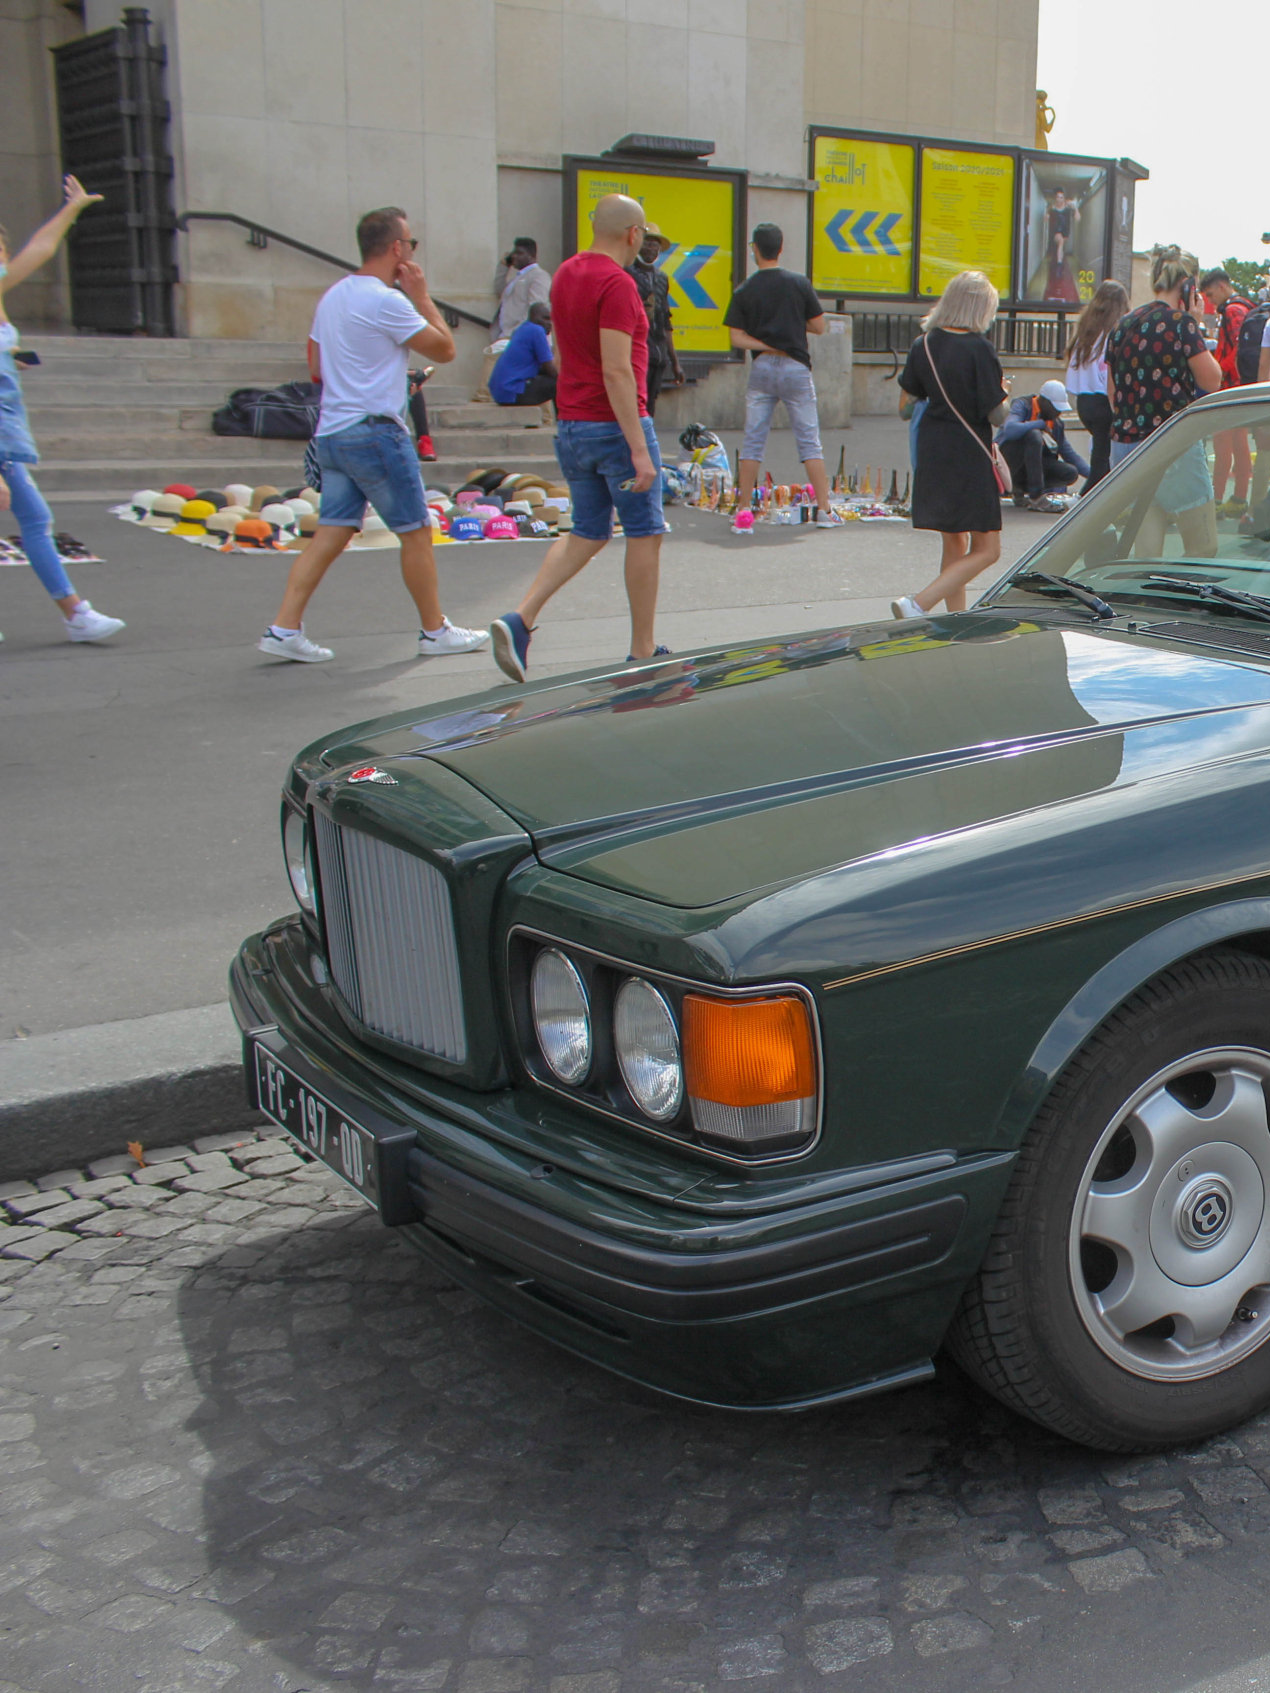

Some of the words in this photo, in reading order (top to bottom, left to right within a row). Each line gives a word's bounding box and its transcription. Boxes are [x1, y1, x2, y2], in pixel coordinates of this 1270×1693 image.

[1079, 270, 1095, 284] 20
[1080, 286, 1093, 300] 21
[459, 522, 479, 532] PARIS
[491, 521, 513, 531] PARIS
